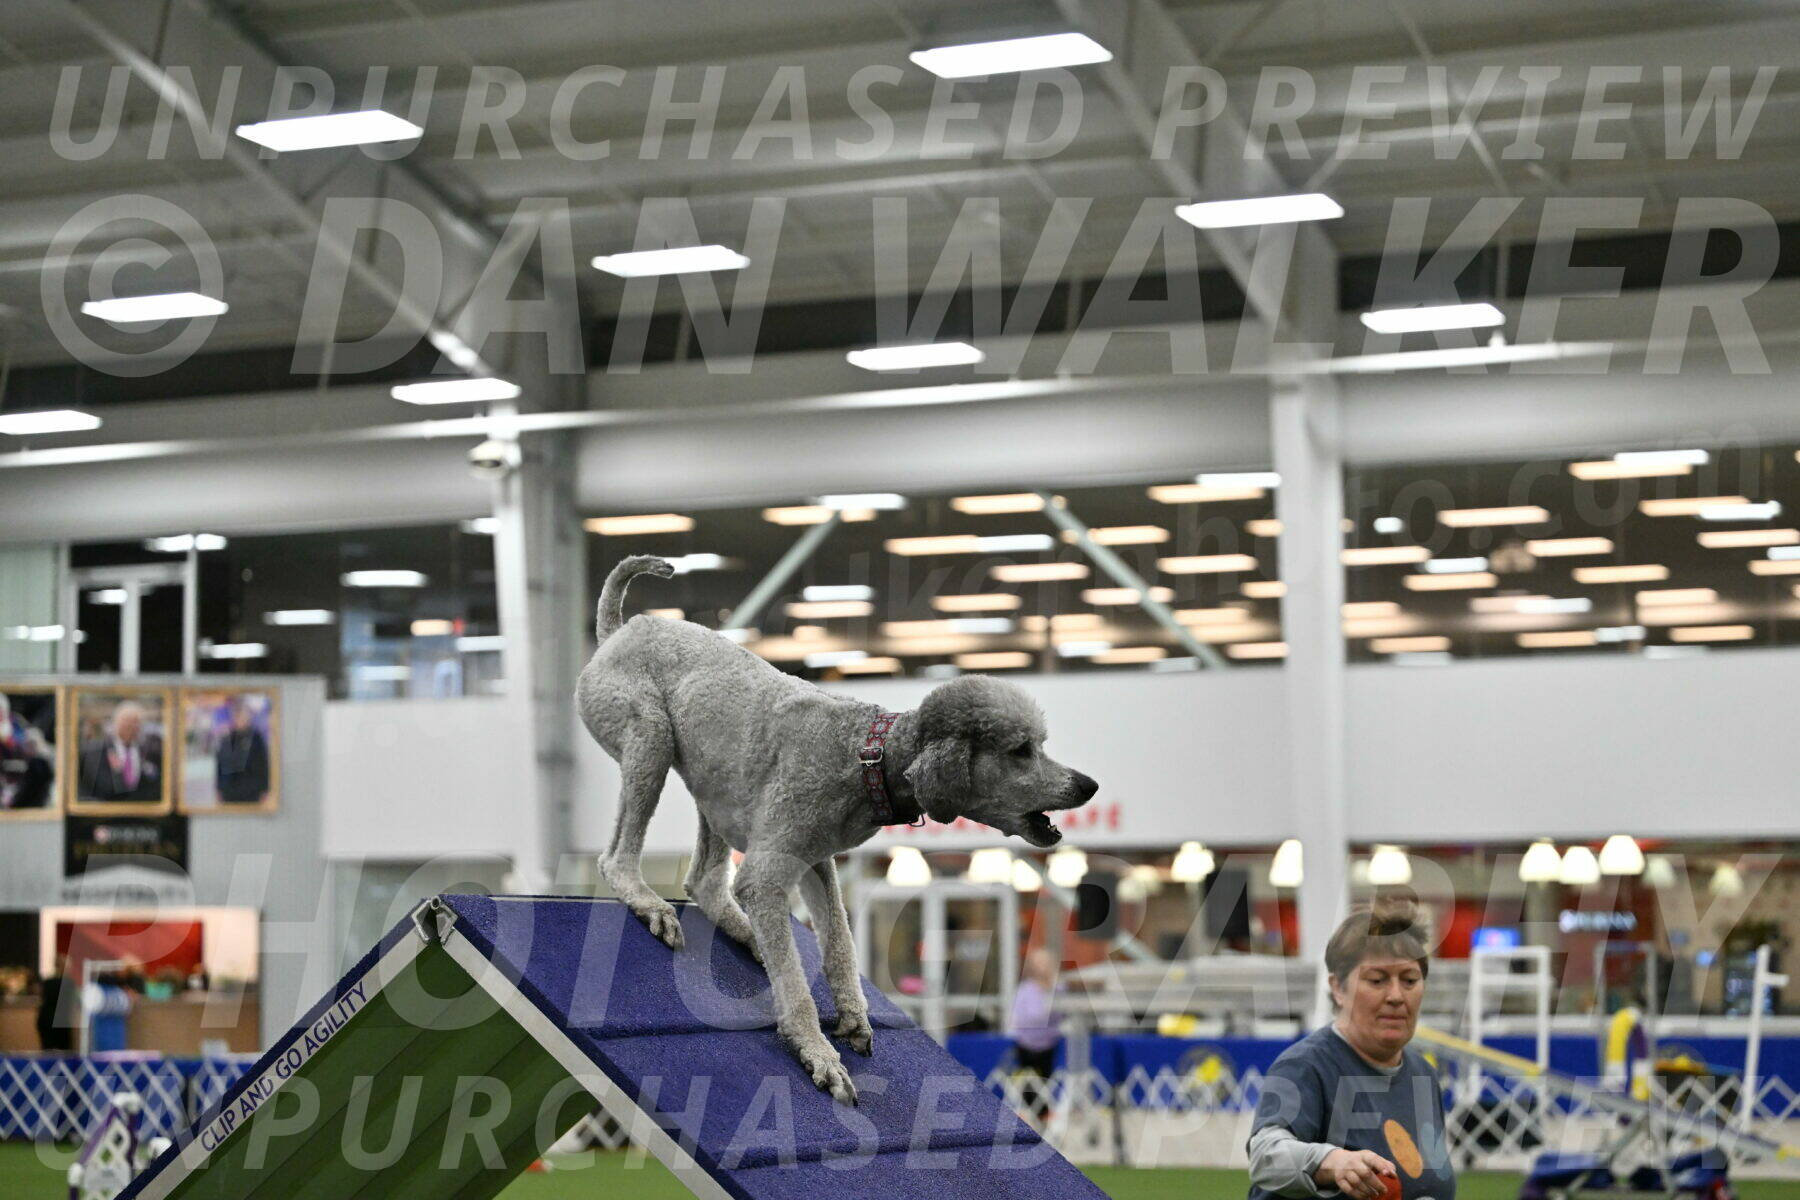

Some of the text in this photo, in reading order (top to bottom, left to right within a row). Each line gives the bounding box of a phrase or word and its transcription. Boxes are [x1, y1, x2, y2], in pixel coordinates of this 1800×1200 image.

[201, 981, 367, 1151] CLIP AND GO AGILITY
